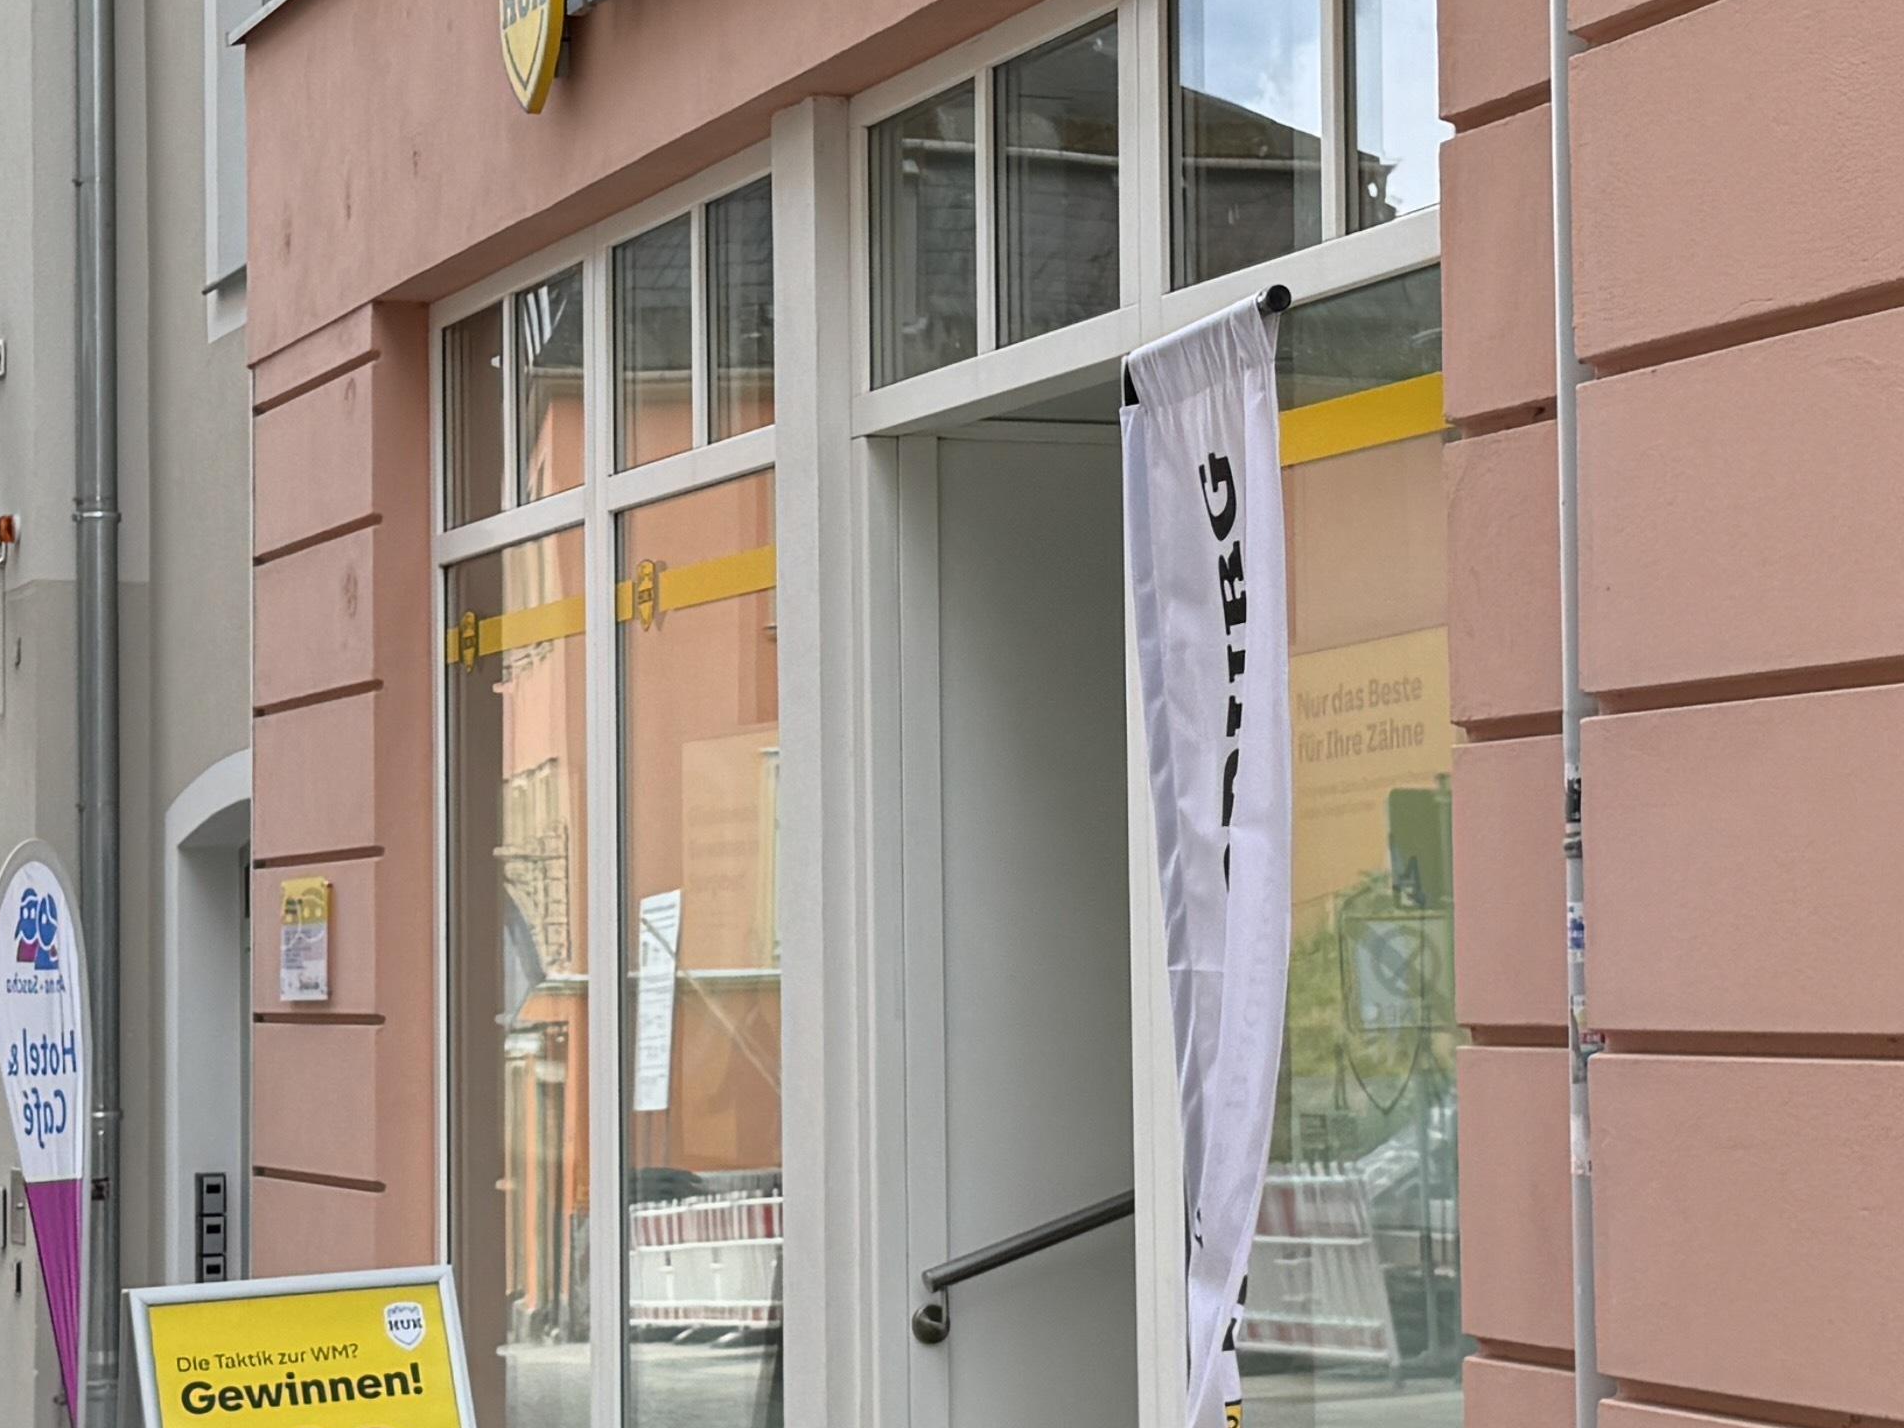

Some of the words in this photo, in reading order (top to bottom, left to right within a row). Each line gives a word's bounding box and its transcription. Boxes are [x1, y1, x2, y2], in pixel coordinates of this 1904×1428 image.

[1331, 683, 1364, 715] das
[1368, 677, 1423, 708] Beste
[1298, 732, 1324, 763] für
[1326, 728, 1362, 760] Ihre
[1366, 718, 1424, 753] Zähne
[388, 1317, 423, 1331] HUK
[176, 1356, 210, 1373] Die
[214, 1350, 273, 1370] Taktik
[278, 1350, 306, 1365] zur
[309, 1343, 359, 1362] WM?
[180, 1362, 424, 1415] Gewinnen!
